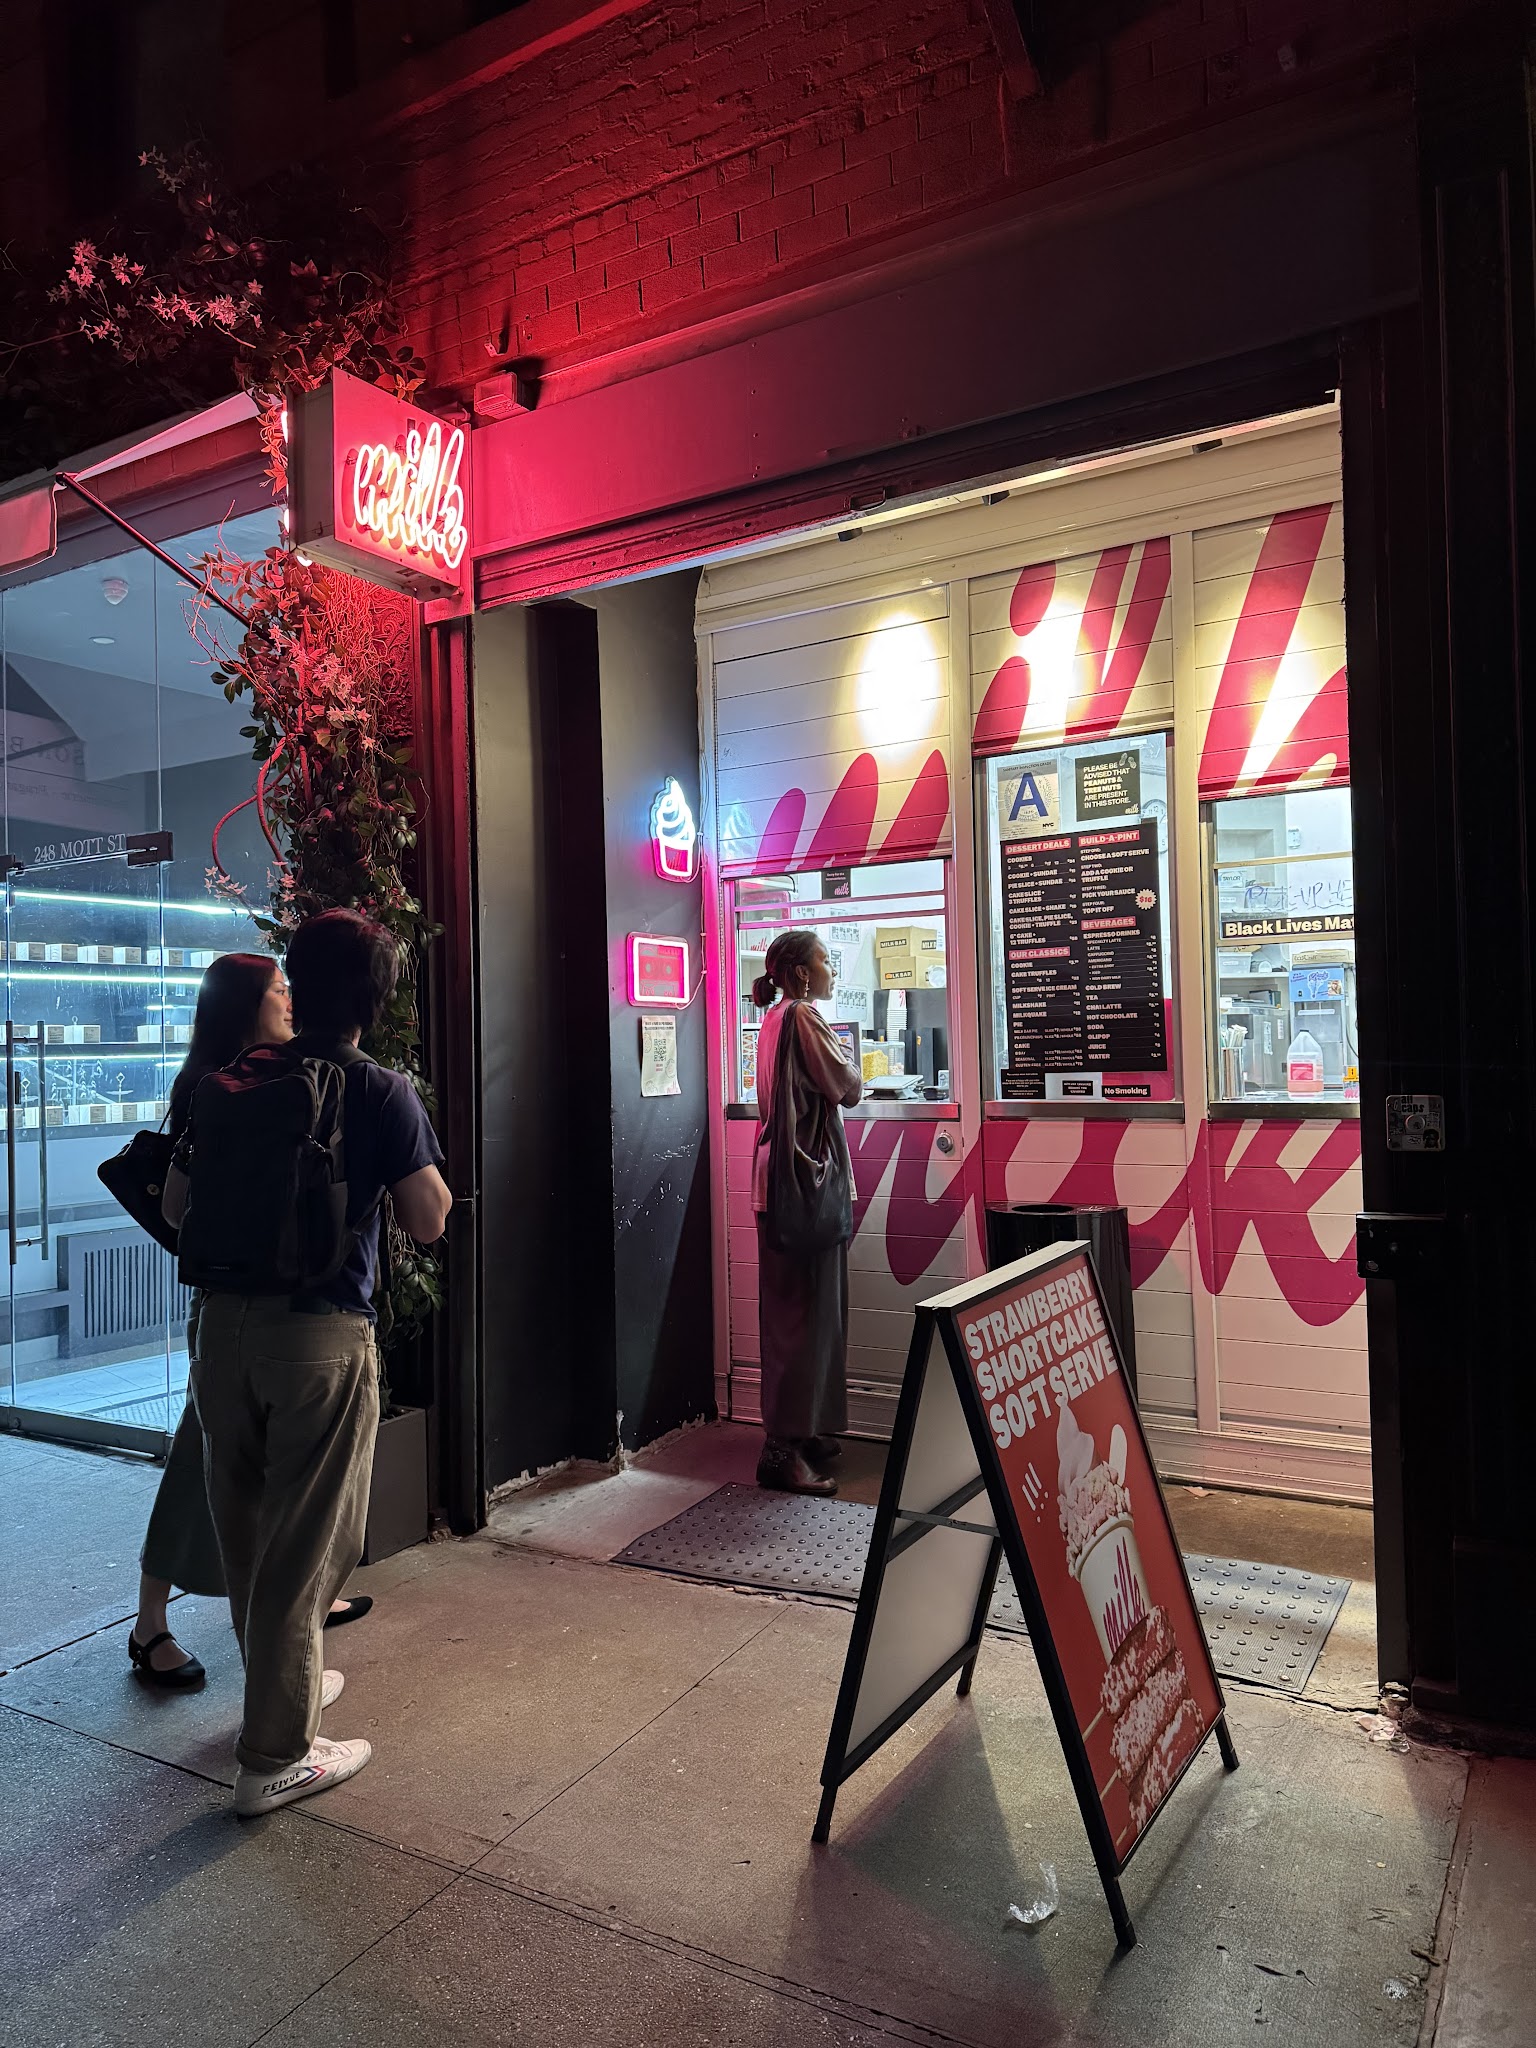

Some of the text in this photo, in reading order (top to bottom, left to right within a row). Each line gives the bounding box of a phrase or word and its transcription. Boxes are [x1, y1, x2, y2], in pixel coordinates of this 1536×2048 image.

[353, 422, 467, 569] milk
[1083, 764, 1109, 773] PLEASE
[1084, 767, 1130, 780] ADVISED THAT
[1084, 778, 1116, 787] PEANUTS
[1084, 784, 1121, 794] TREE NUTS
[1008, 772, 1049, 821] A
[1084, 790, 1128, 802] ARE PRESENT
[1092, 799, 1108, 807] THIS
[1108, 797, 1131, 806] STORE.
[1081, 832, 1137, 845] BUILD-A-PINT
[34, 833, 125, 863] 248 MOTT ST
[1007, 840, 1069, 853] DESSERT DEALS
[1007, 869, 1058, 880] COOKIE SUNDAE
[1100, 867, 1124, 875] COOKIE
[1038, 878, 1063, 886] SUNDAE
[1081, 875, 1108, 883] TRUFFLE
[834, 882, 850, 896] milk
[1035, 920, 1061, 928] TRUFFLE
[1083, 918, 1134, 929] BEVERAGES
[1225, 922, 1274, 936] Black
[1276, 917, 1322, 933] Lives
[1083, 931, 1116, 939] ESPRESSO
[922, 941, 934, 949] MILK
[1017, 937, 1046, 945] TRUFFLES
[1028, 948, 1069, 957] CLASSICS
[1027, 969, 1057, 977] TRUFFLES
[1115, 1087, 1148, 1095] Smoking
[1401, 1095, 1413, 1104] all
[1401, 1104, 1425, 1114] caps
[964, 1265, 1093, 1360] STRAWBERRY
[976, 1298, 1106, 1401] SHORTCAKE
[989, 1335, 1119, 1450] SOFT SERVE
[262, 1771, 300, 1795] FEIYUE
